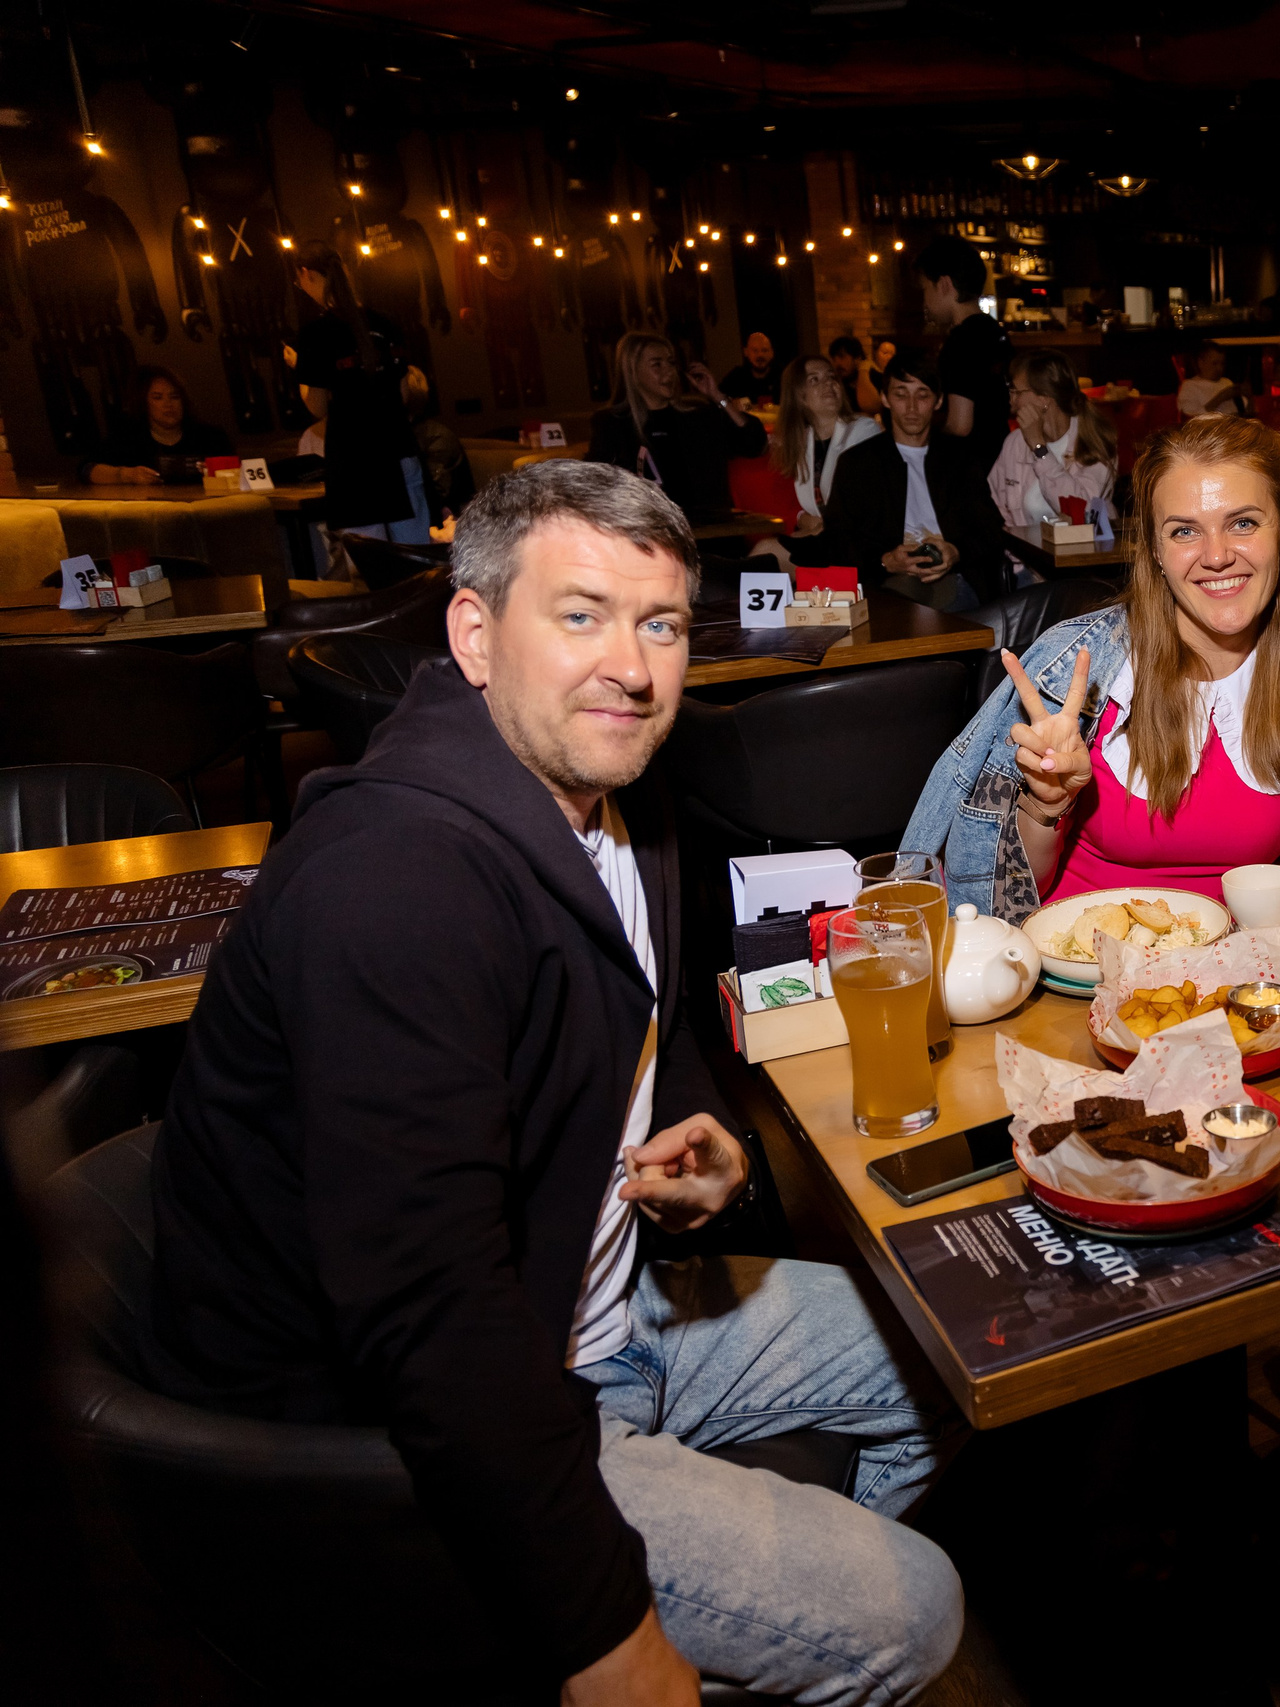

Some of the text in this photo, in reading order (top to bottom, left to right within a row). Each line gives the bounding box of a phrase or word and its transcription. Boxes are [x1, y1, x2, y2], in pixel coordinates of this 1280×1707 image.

[246, 467, 266, 481] 36
[747, 589, 783, 611] 37
[1007, 1204, 1075, 1265] МЕНЮ
